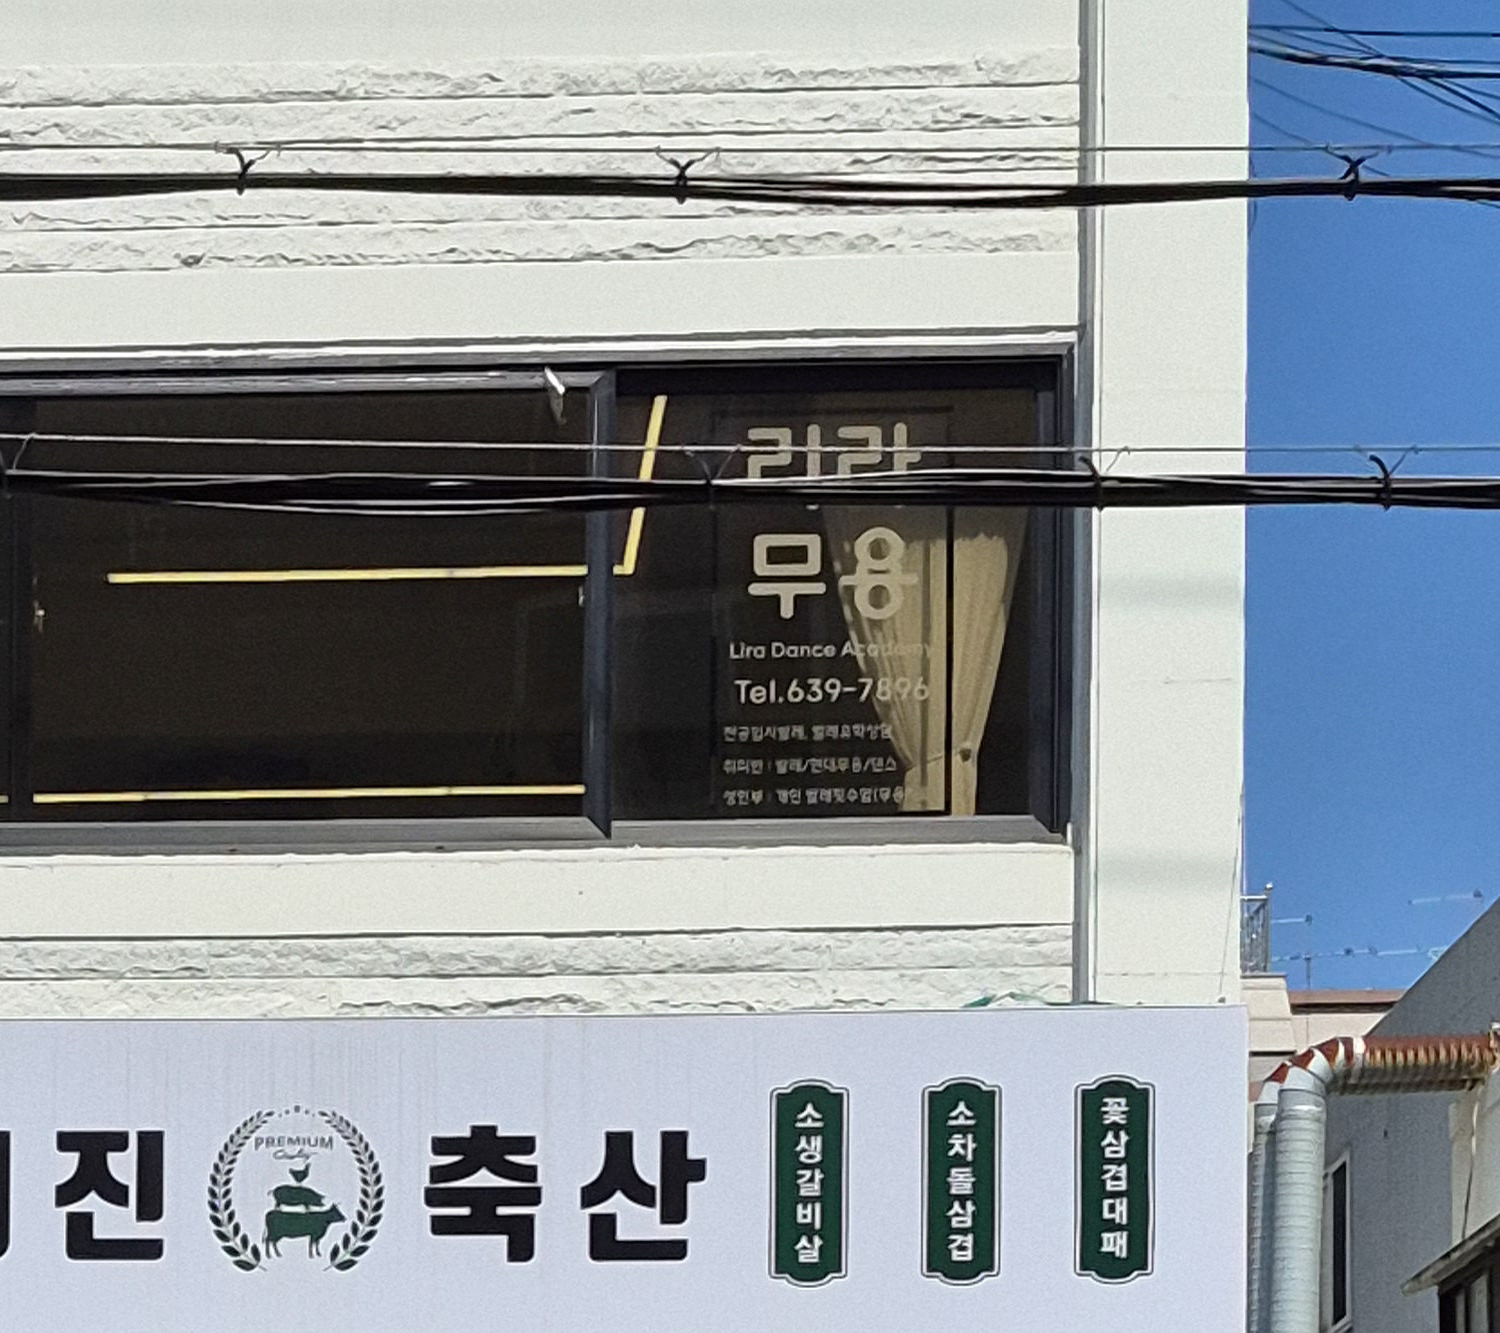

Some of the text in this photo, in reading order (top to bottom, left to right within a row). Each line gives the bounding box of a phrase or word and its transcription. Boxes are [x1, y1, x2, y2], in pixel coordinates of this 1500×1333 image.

[747, 422, 922, 508] 리라
[747, 526, 919, 620] 무용
[729, 641, 766, 659] Lira
[771, 641, 836, 659] Dance
[734, 677, 930, 705] Tel.639-7896
[254, 1135, 333, 1151] PREMIUM
[794, 1101, 824, 1264] 소생갈비살
[945, 1100, 977, 1263] 소차돌삼겹
[1099, 1096, 1129, 1260] 꽃삼겹대패
[423, 1125, 708, 1263] 축산
